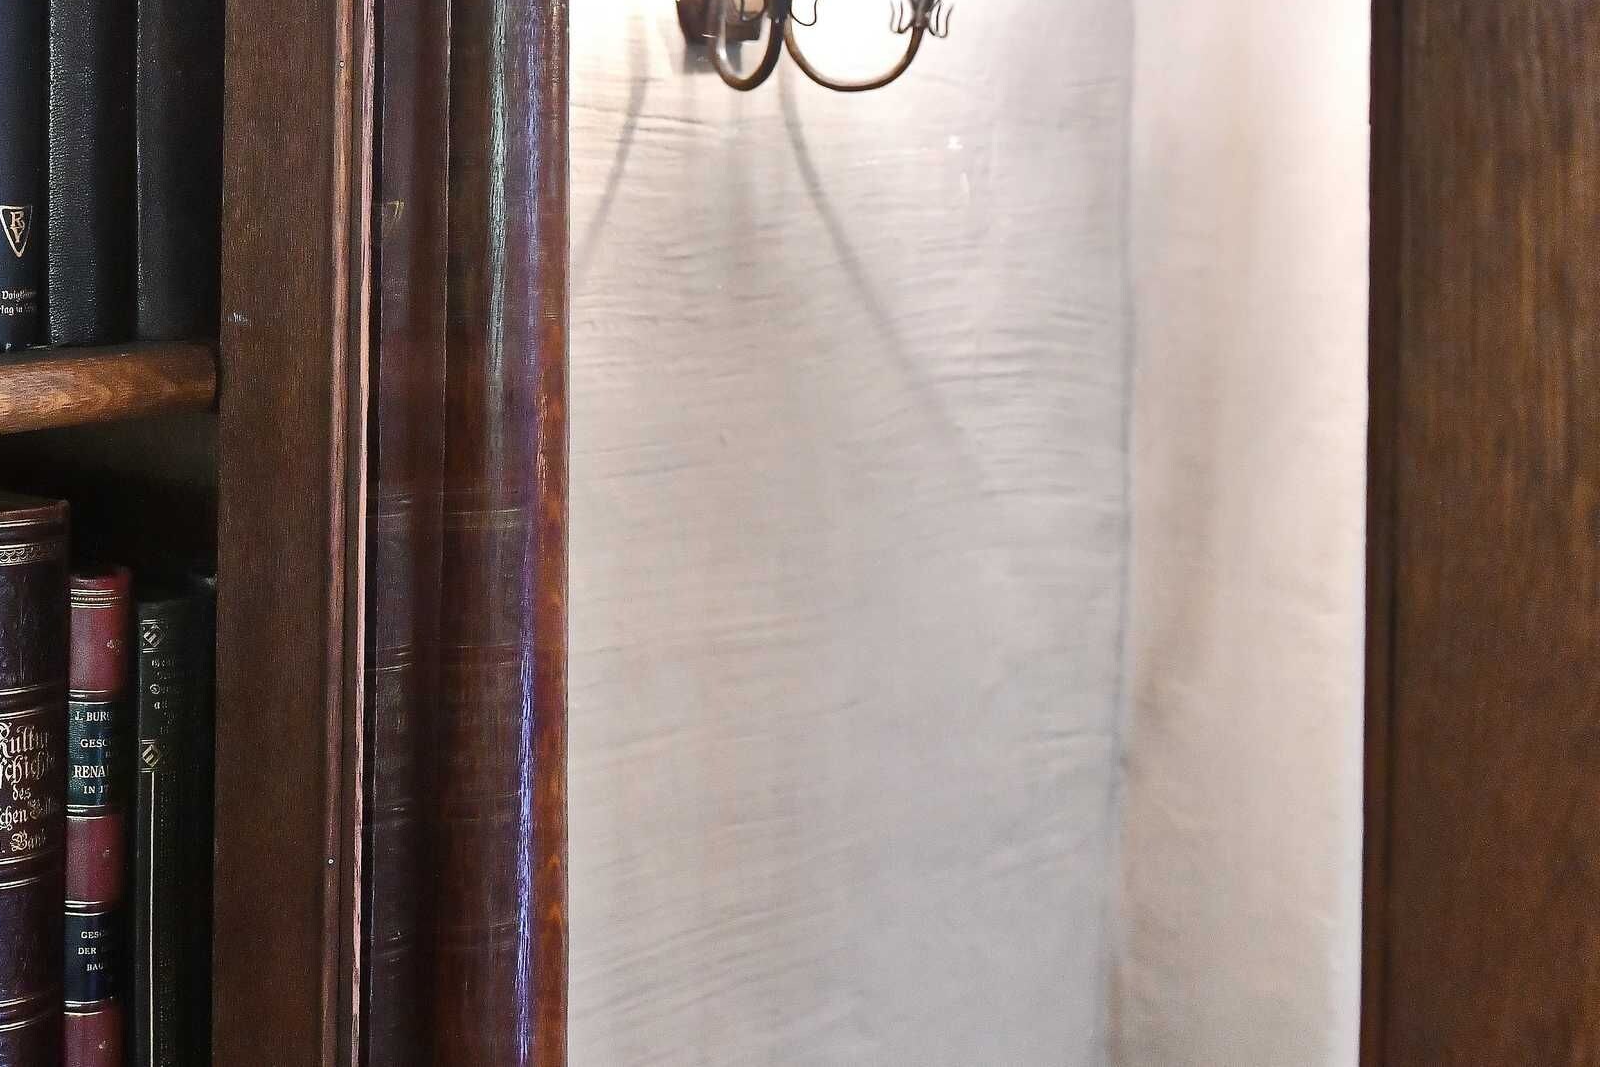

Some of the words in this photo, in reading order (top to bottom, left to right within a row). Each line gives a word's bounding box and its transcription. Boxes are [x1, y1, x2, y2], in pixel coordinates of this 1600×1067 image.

[12, 783, 32, 801] des
[83, 784, 97, 795] IN
[77, 946, 98, 956] DER
